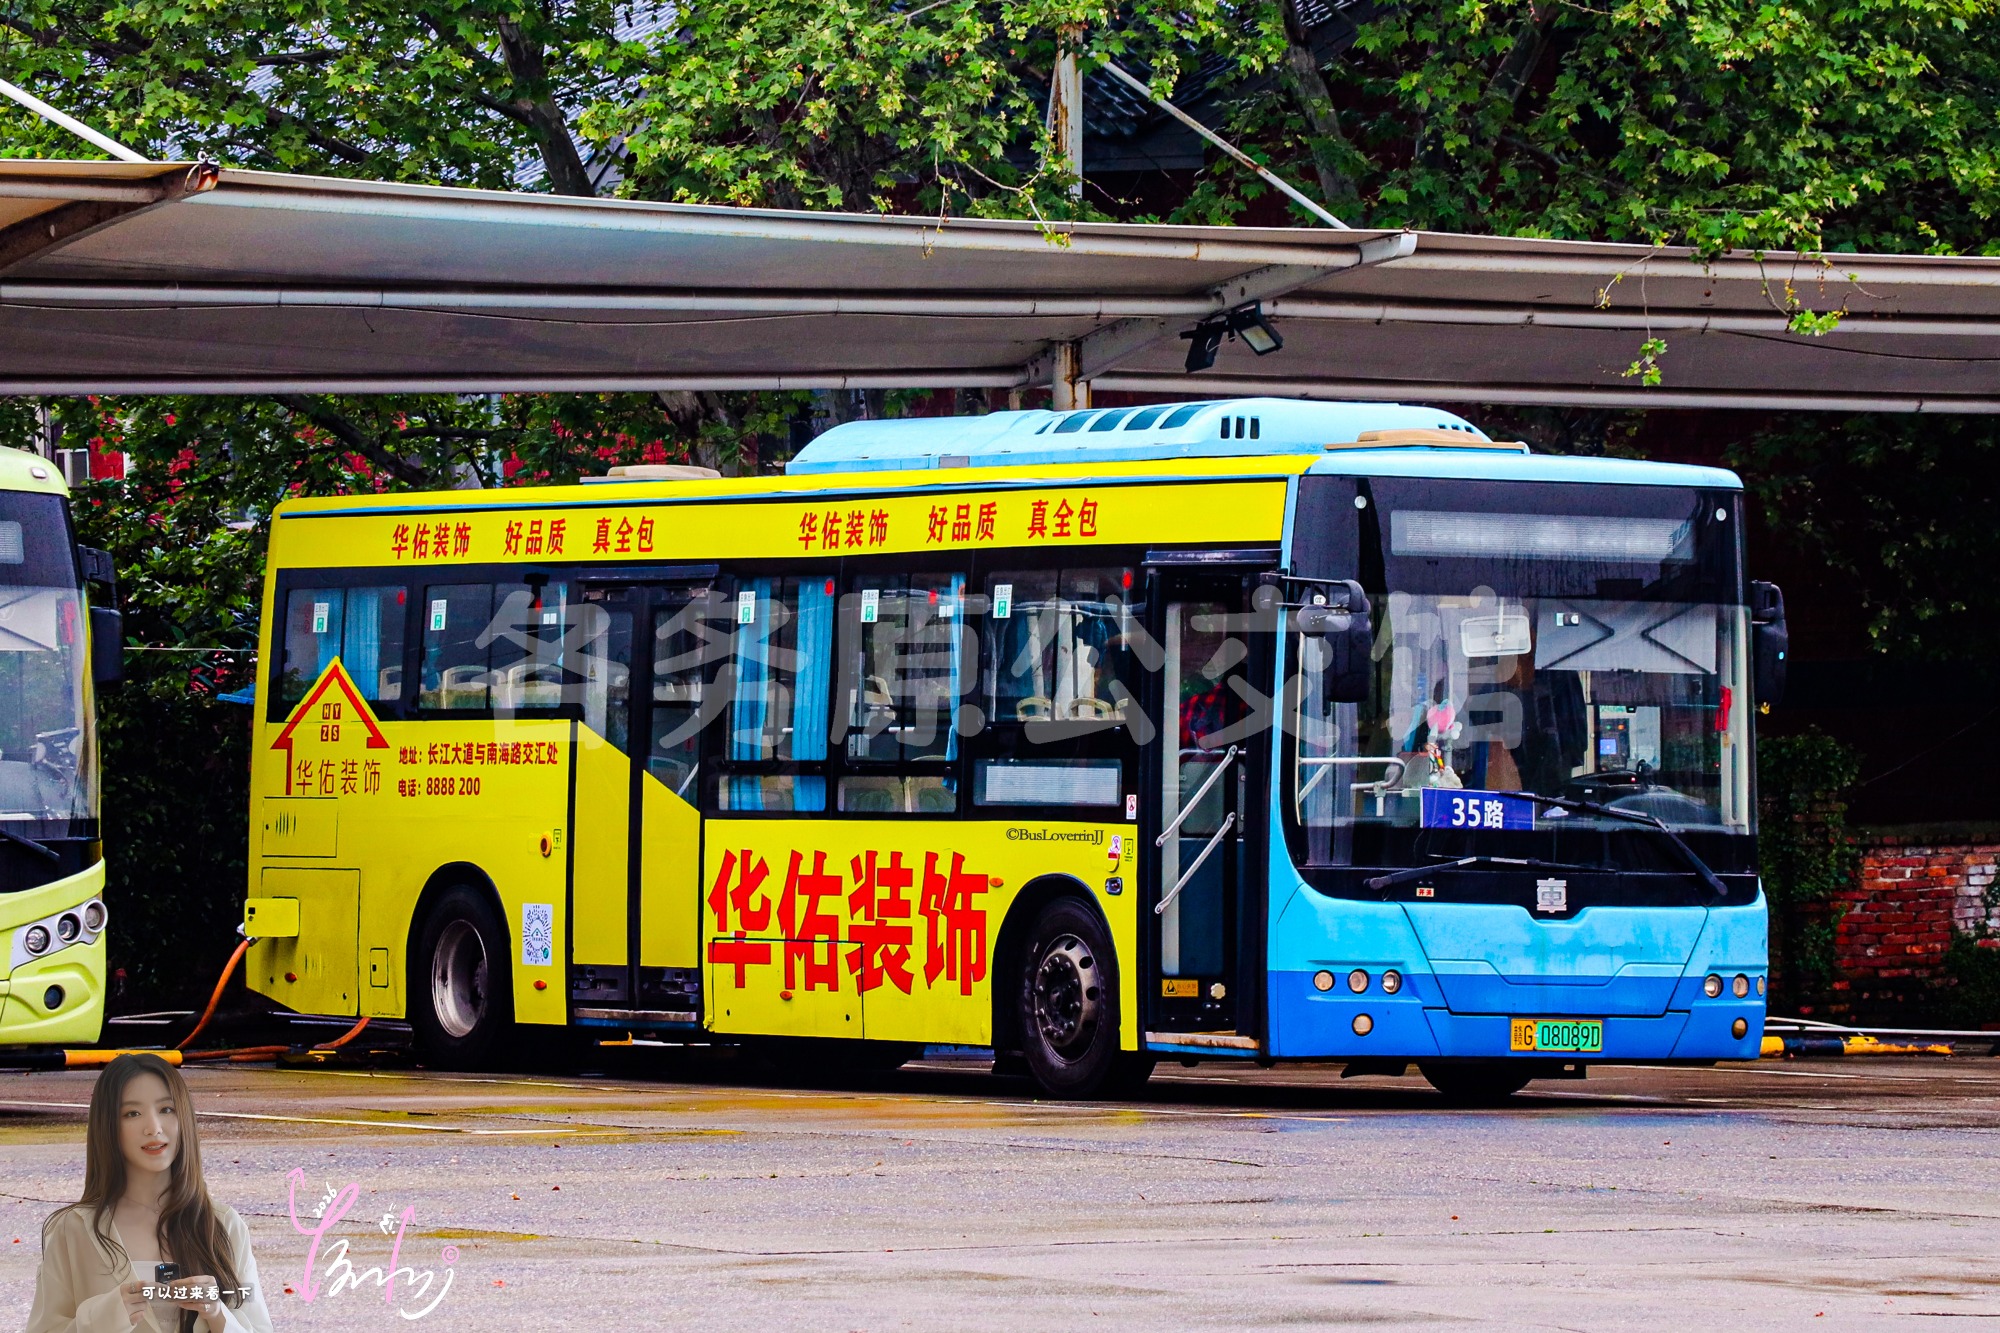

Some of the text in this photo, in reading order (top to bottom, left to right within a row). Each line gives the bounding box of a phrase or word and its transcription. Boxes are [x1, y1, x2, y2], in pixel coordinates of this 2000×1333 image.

[391, 515, 655, 560] 华佑装饰 好品质 真全包
[798, 497, 1098, 550] 华佑装饰 好品质 真全包
[296, 759, 381, 796] 华佑装饰
[1452, 798, 1504, 829] 35路
[707, 849, 988, 997] 华佑装饰
